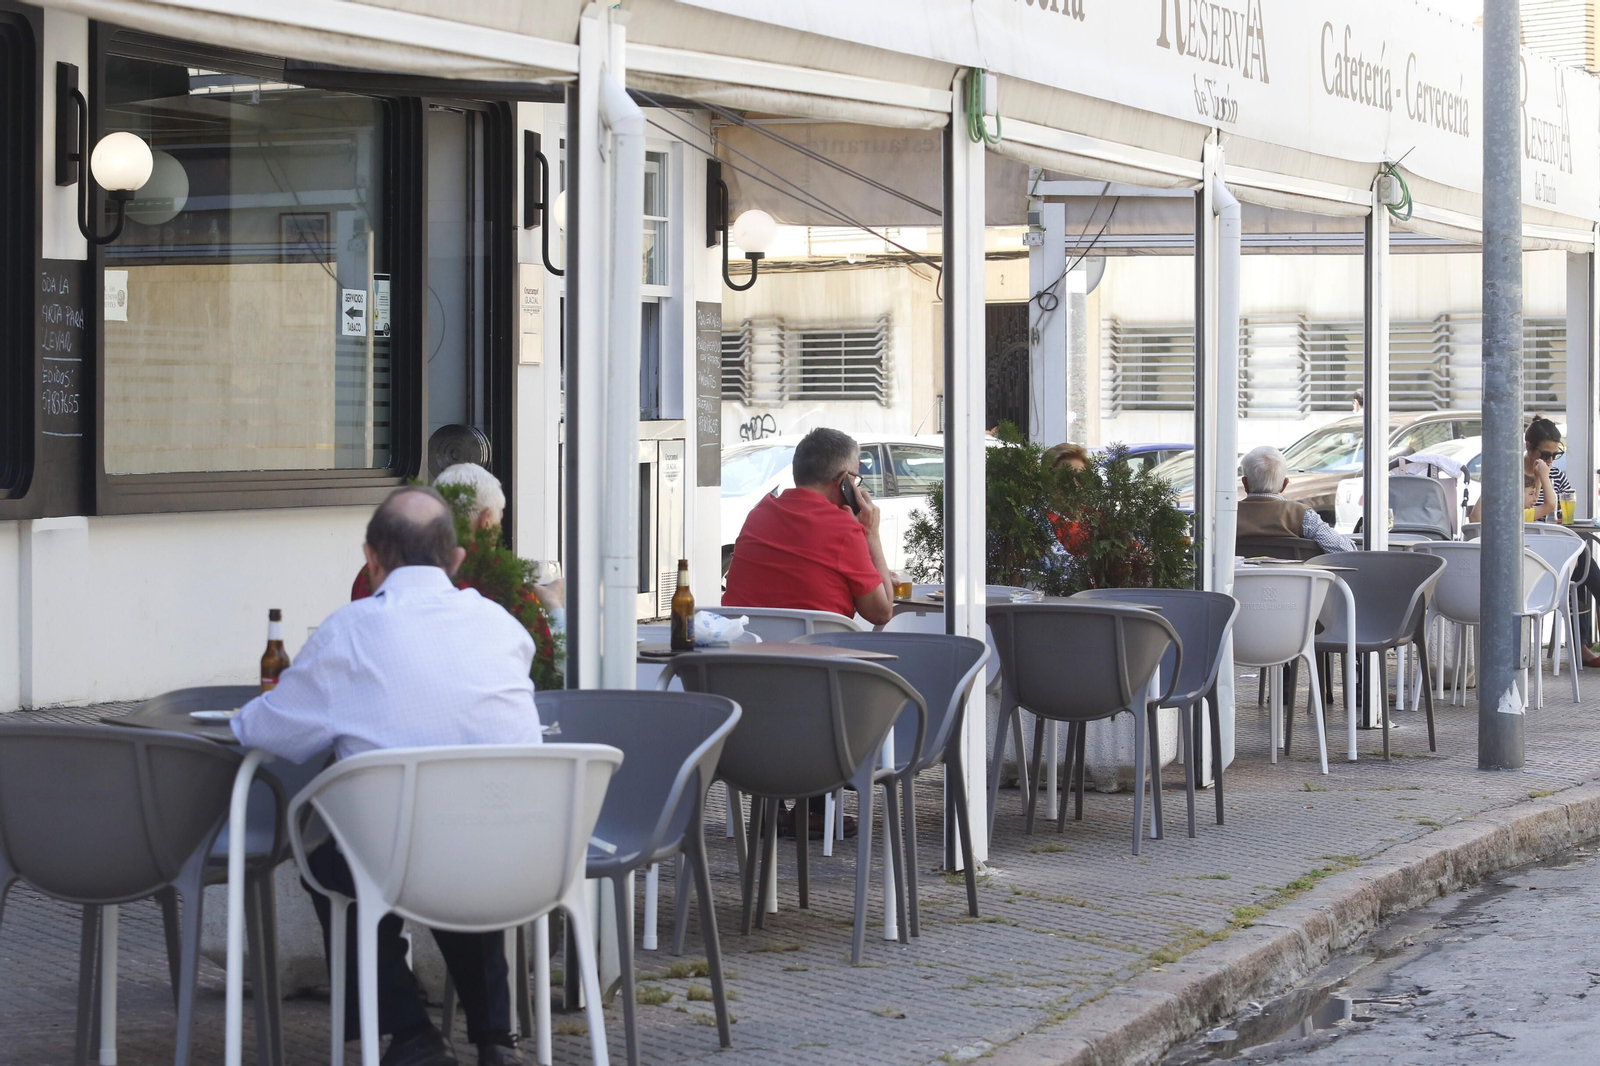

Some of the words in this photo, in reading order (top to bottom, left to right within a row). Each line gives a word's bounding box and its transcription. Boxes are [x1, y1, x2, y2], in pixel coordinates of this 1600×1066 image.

[1321, 21, 1393, 112] Cafetería
[1405, 52, 1470, 138] Cervecería
[1193, 72, 1209, 117] de
[1204, 78, 1238, 124] Turín
[41, 272, 56, 293] ODA
[59, 275, 69, 294] LA
[345, 293, 364, 304] SERVICIOS
[41, 303, 63, 324] ARTA
[65, 305, 85, 330] PARA
[347, 322, 361, 332] TABACO
[41, 327, 72, 352] LEVAR
[41, 364, 75, 388] EDIDOS:
[41, 389, 80, 415] 57837655
